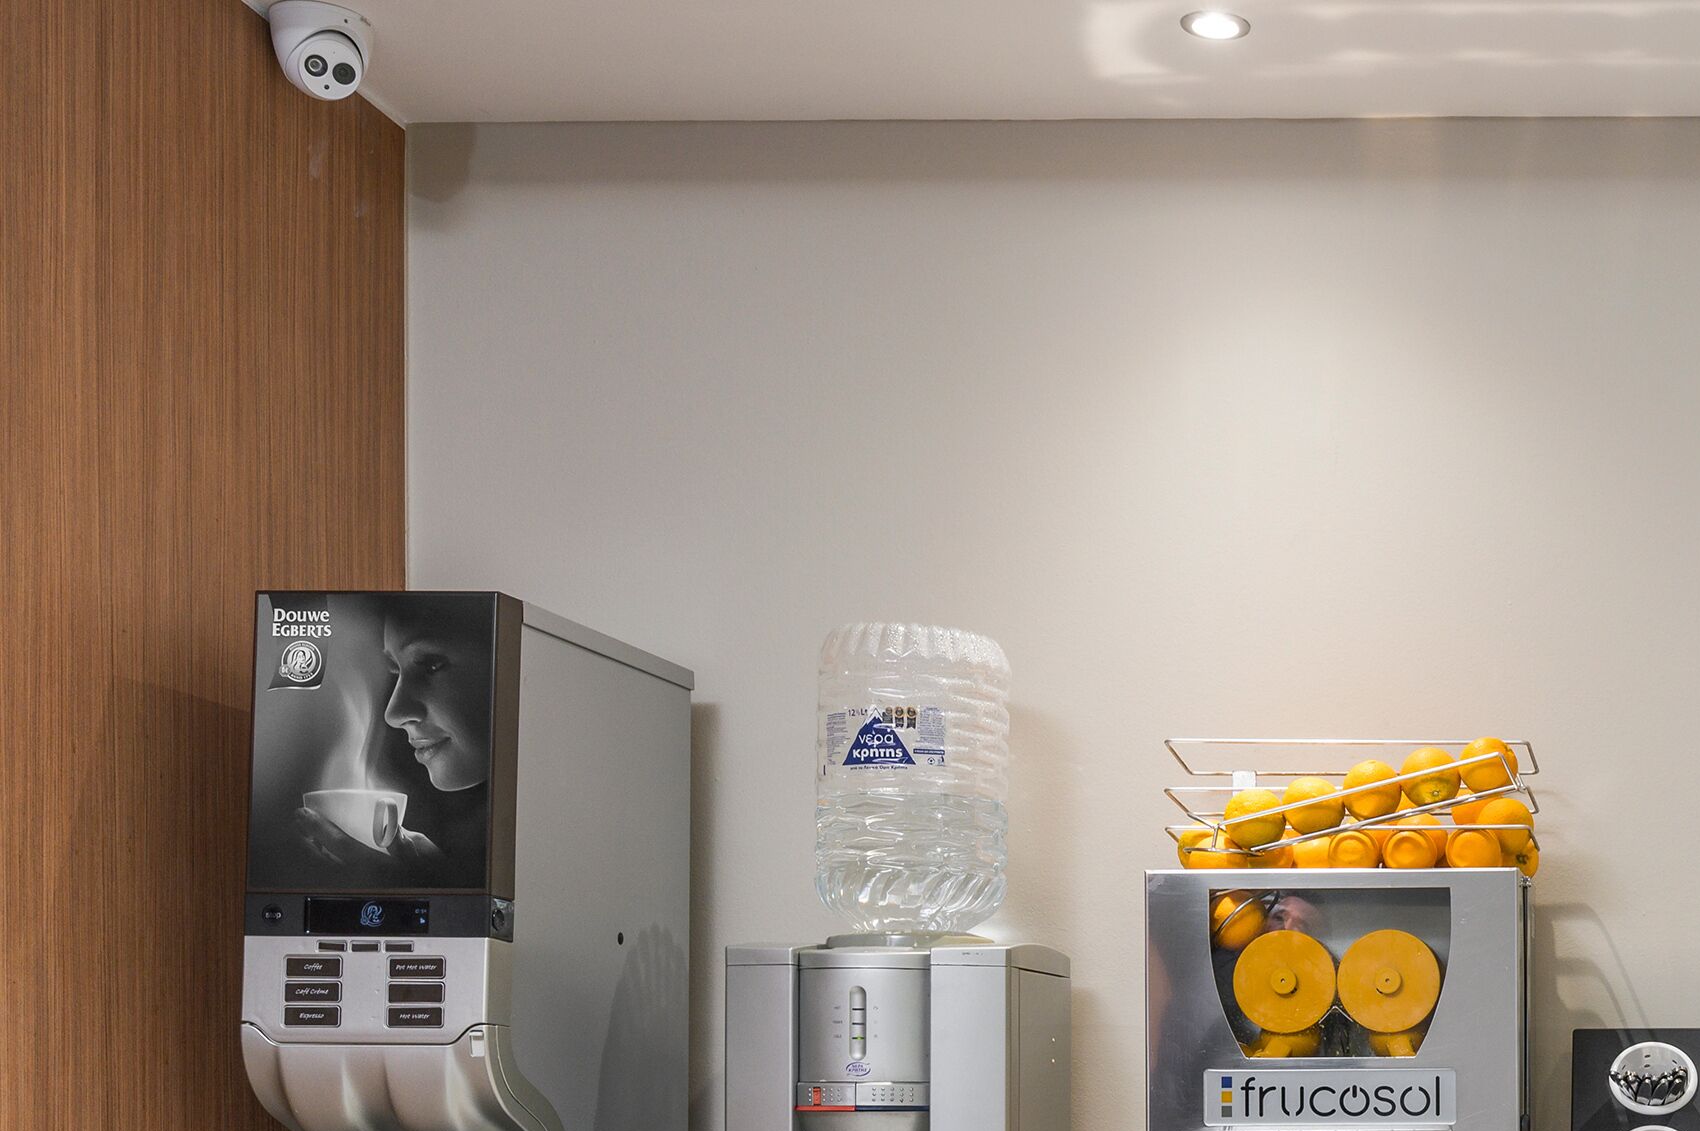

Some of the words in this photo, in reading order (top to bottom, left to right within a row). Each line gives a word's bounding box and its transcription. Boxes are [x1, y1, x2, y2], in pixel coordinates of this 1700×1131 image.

[273, 608, 330, 622] Douwe
[272, 623, 332, 639] EGBERTS
[303, 962, 323, 971] Coffee
[299, 1012, 325, 1020] Espresso
[1241, 1075, 1440, 1117] frucosol
